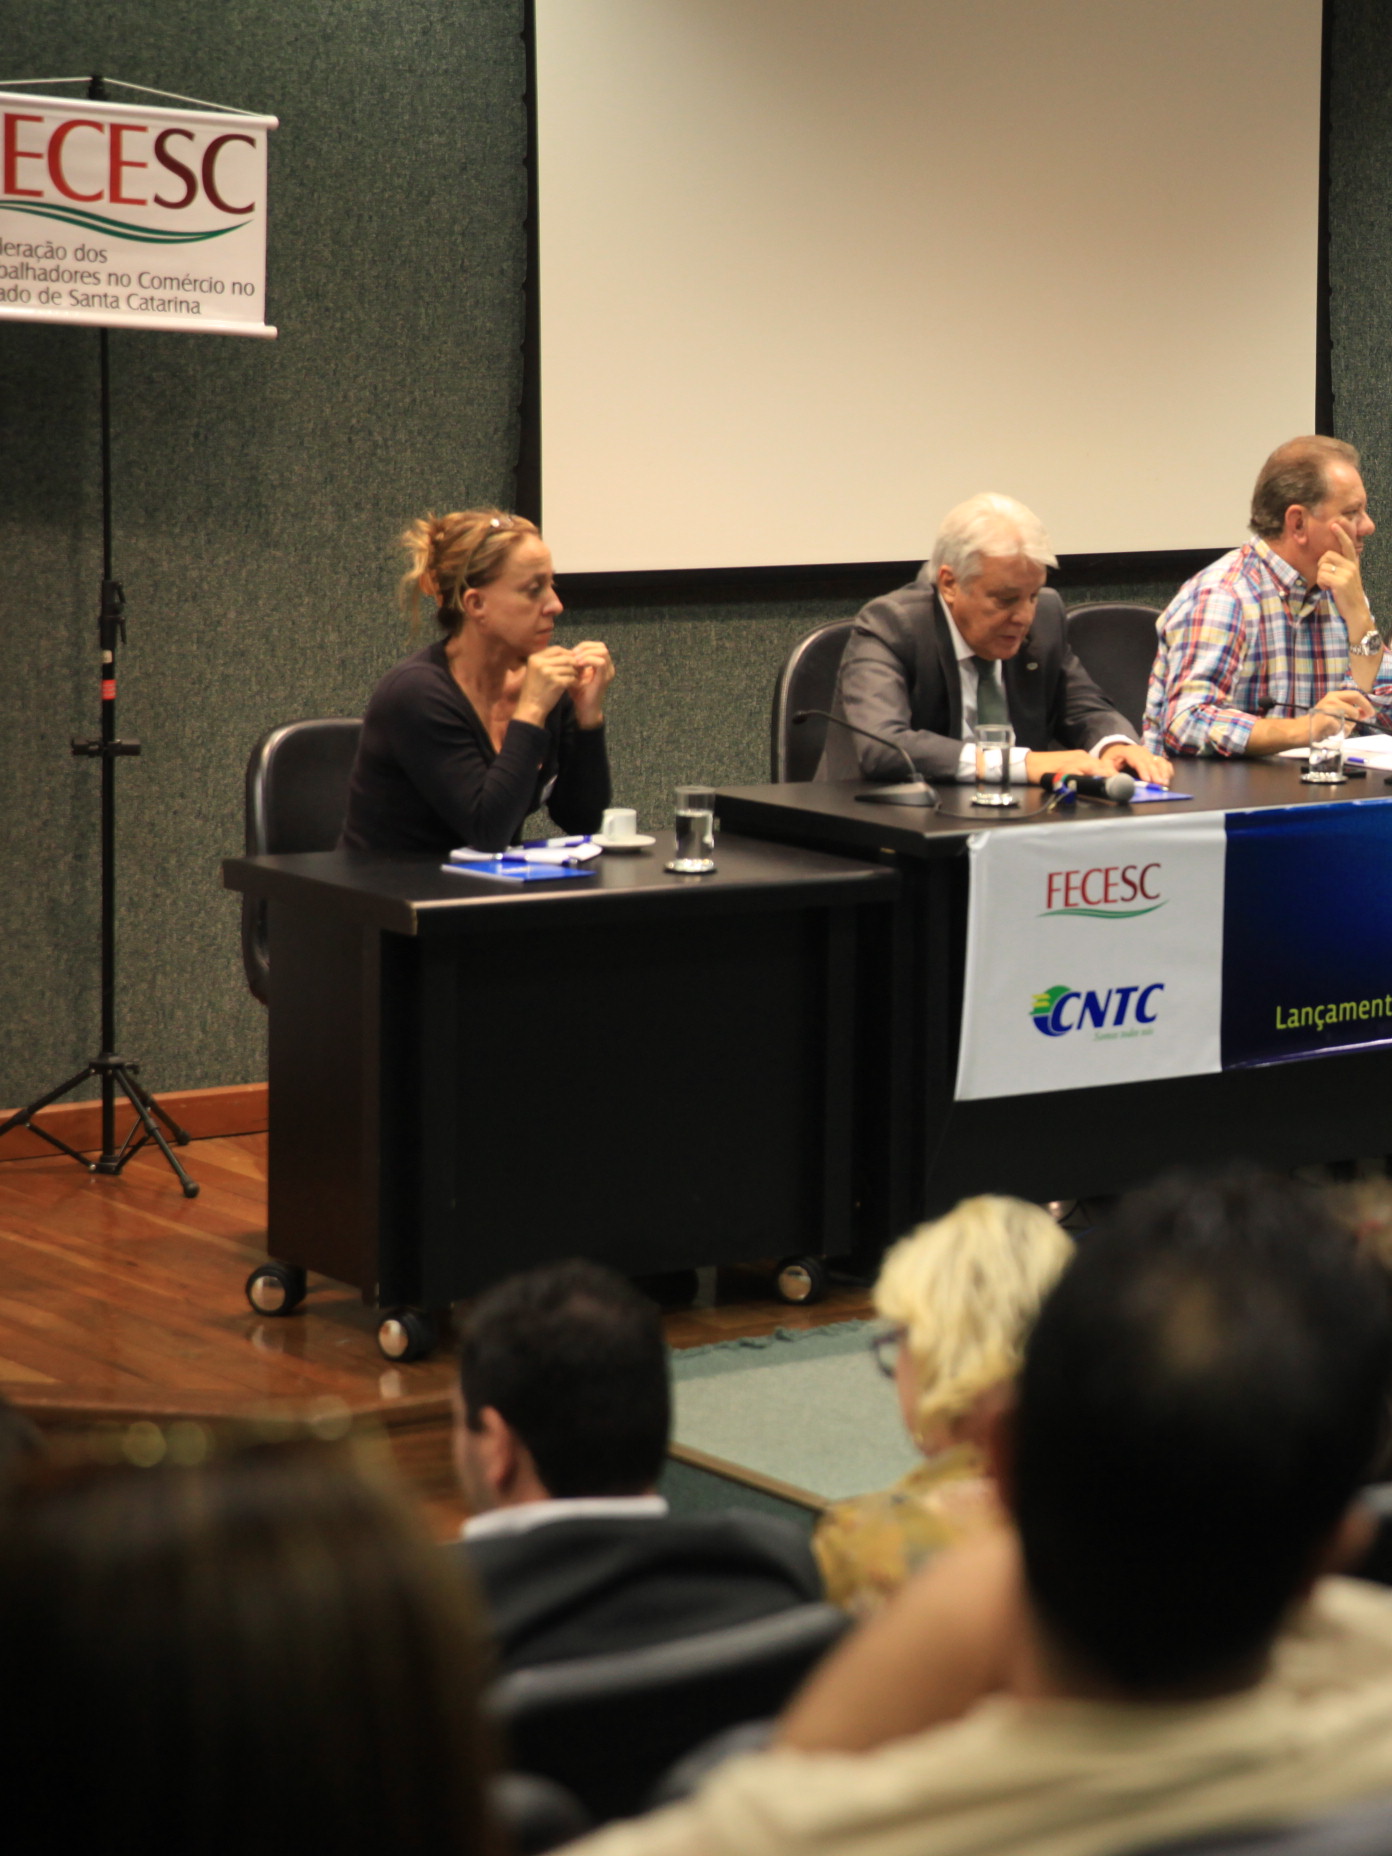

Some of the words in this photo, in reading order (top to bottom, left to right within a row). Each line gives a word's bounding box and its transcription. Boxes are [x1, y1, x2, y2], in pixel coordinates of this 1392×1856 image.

[0, 236, 67, 262] eração
[74, 243, 108, 263] dos
[107, 272, 132, 288] no
[138, 272, 225, 295] Comércio
[231, 281, 255, 297] no
[38, 286, 62, 305] de
[68, 289, 120, 310] Santa
[126, 293, 202, 315] Catarina
[1046, 862, 1162, 909] FECESC
[1050, 983, 1165, 1033] CNTC
